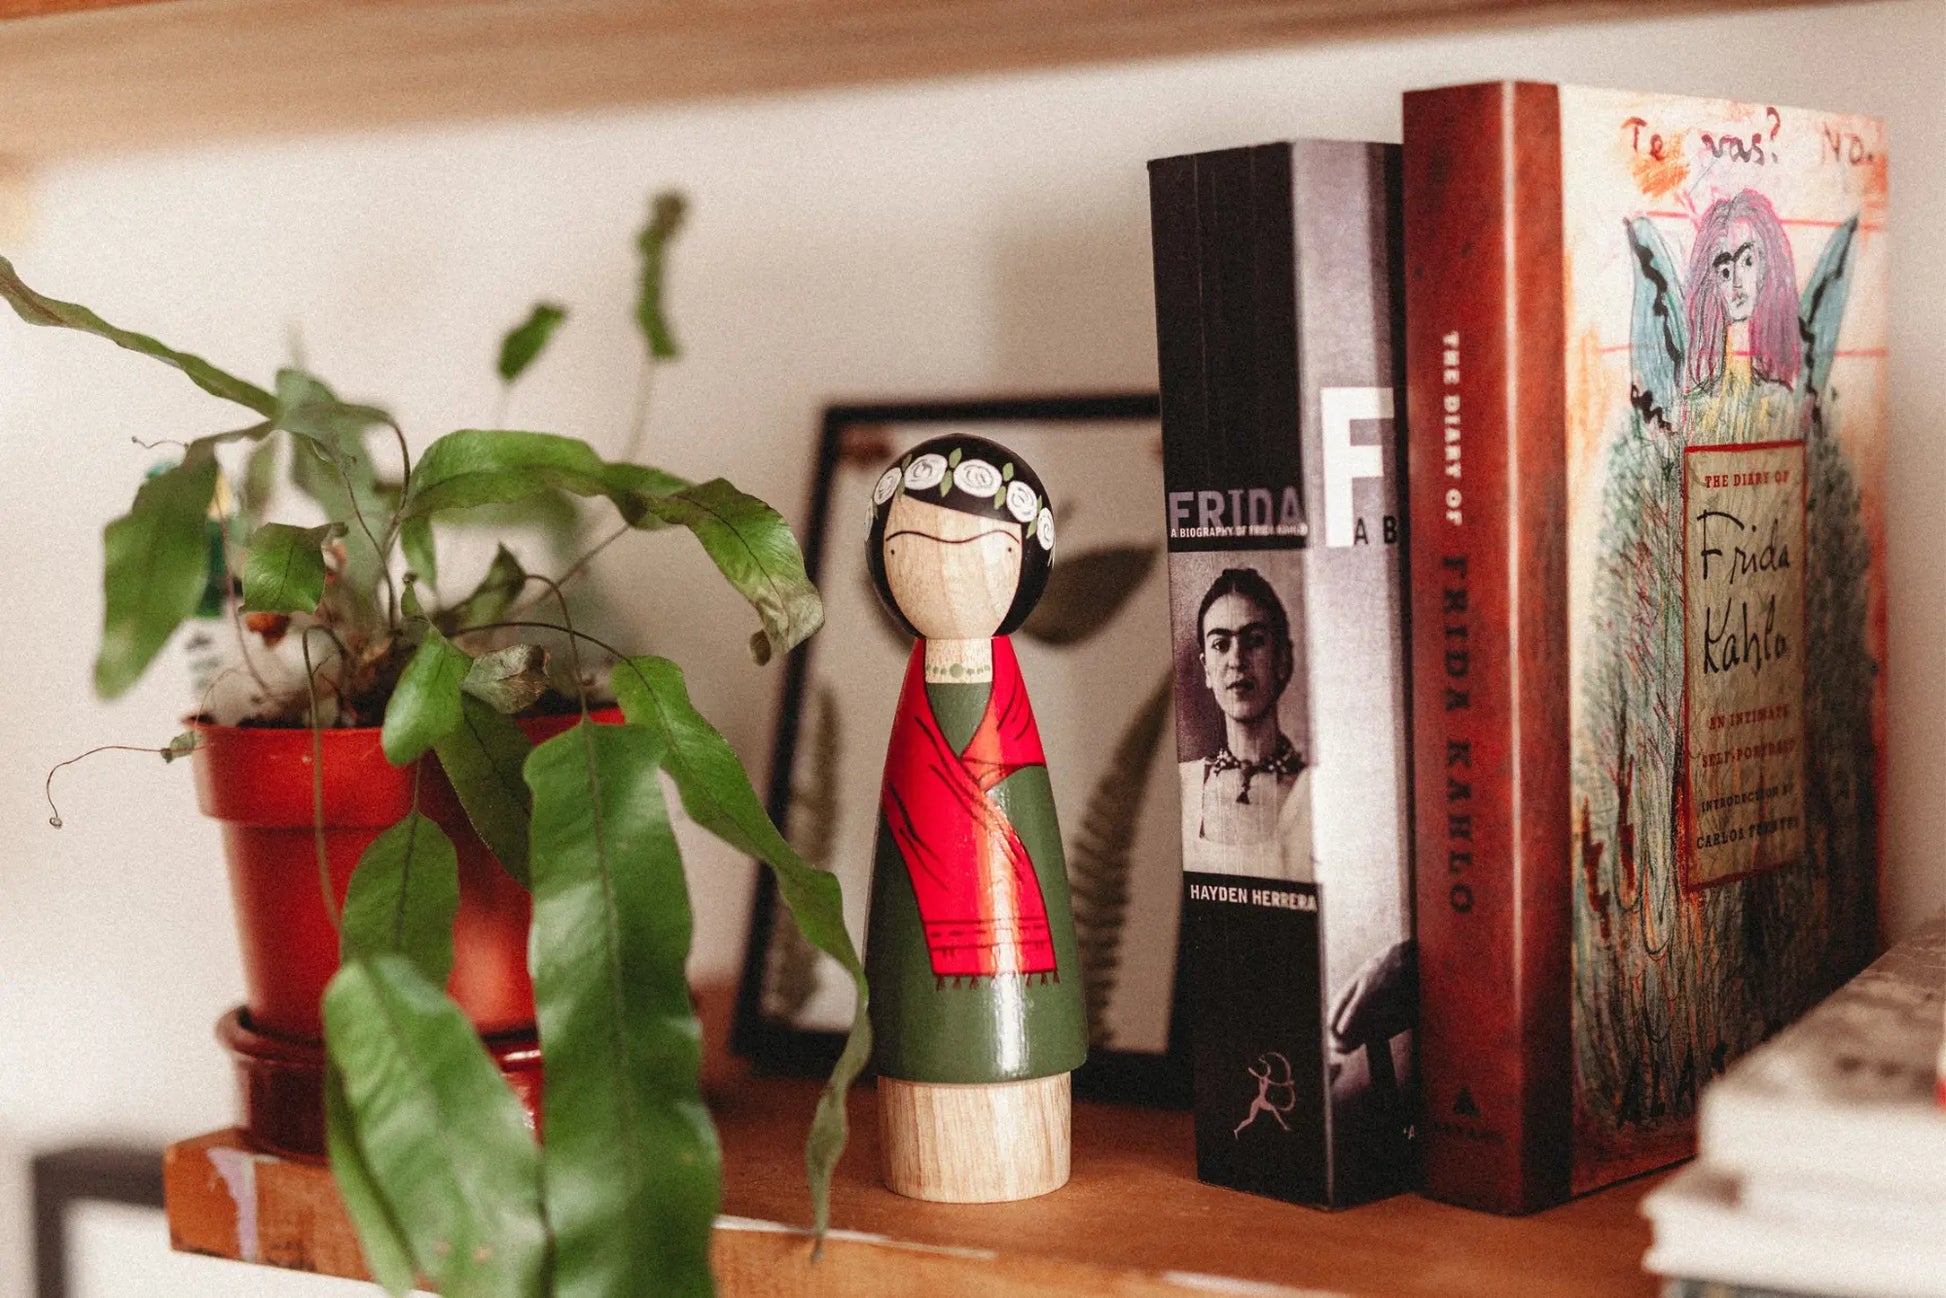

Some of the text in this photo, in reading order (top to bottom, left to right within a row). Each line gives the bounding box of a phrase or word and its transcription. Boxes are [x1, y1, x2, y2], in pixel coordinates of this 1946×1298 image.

[1621, 116, 1667, 161] Te
[1701, 106, 1781, 166] vas?
[1442, 330, 1463, 526] THE DIARY OF
[1704, 470, 1790, 489] THE DIARY OF
[1167, 486, 1307, 530] FRIDA
[1170, 528, 1178, 538] A
[1179, 526, 1234, 539] BIOGRAPHY
[1235, 525, 1248, 537] OF
[1697, 509, 1790, 585] Frida
[1704, 594, 1789, 674] Kahlo
[1443, 556, 1474, 914] FRIDA KAHLO
[1708, 703, 1789, 731] AN INTIMATE
[1696, 828, 1746, 850] CARLOS
[1189, 883, 1318, 913] HAYDEN HERRERA
